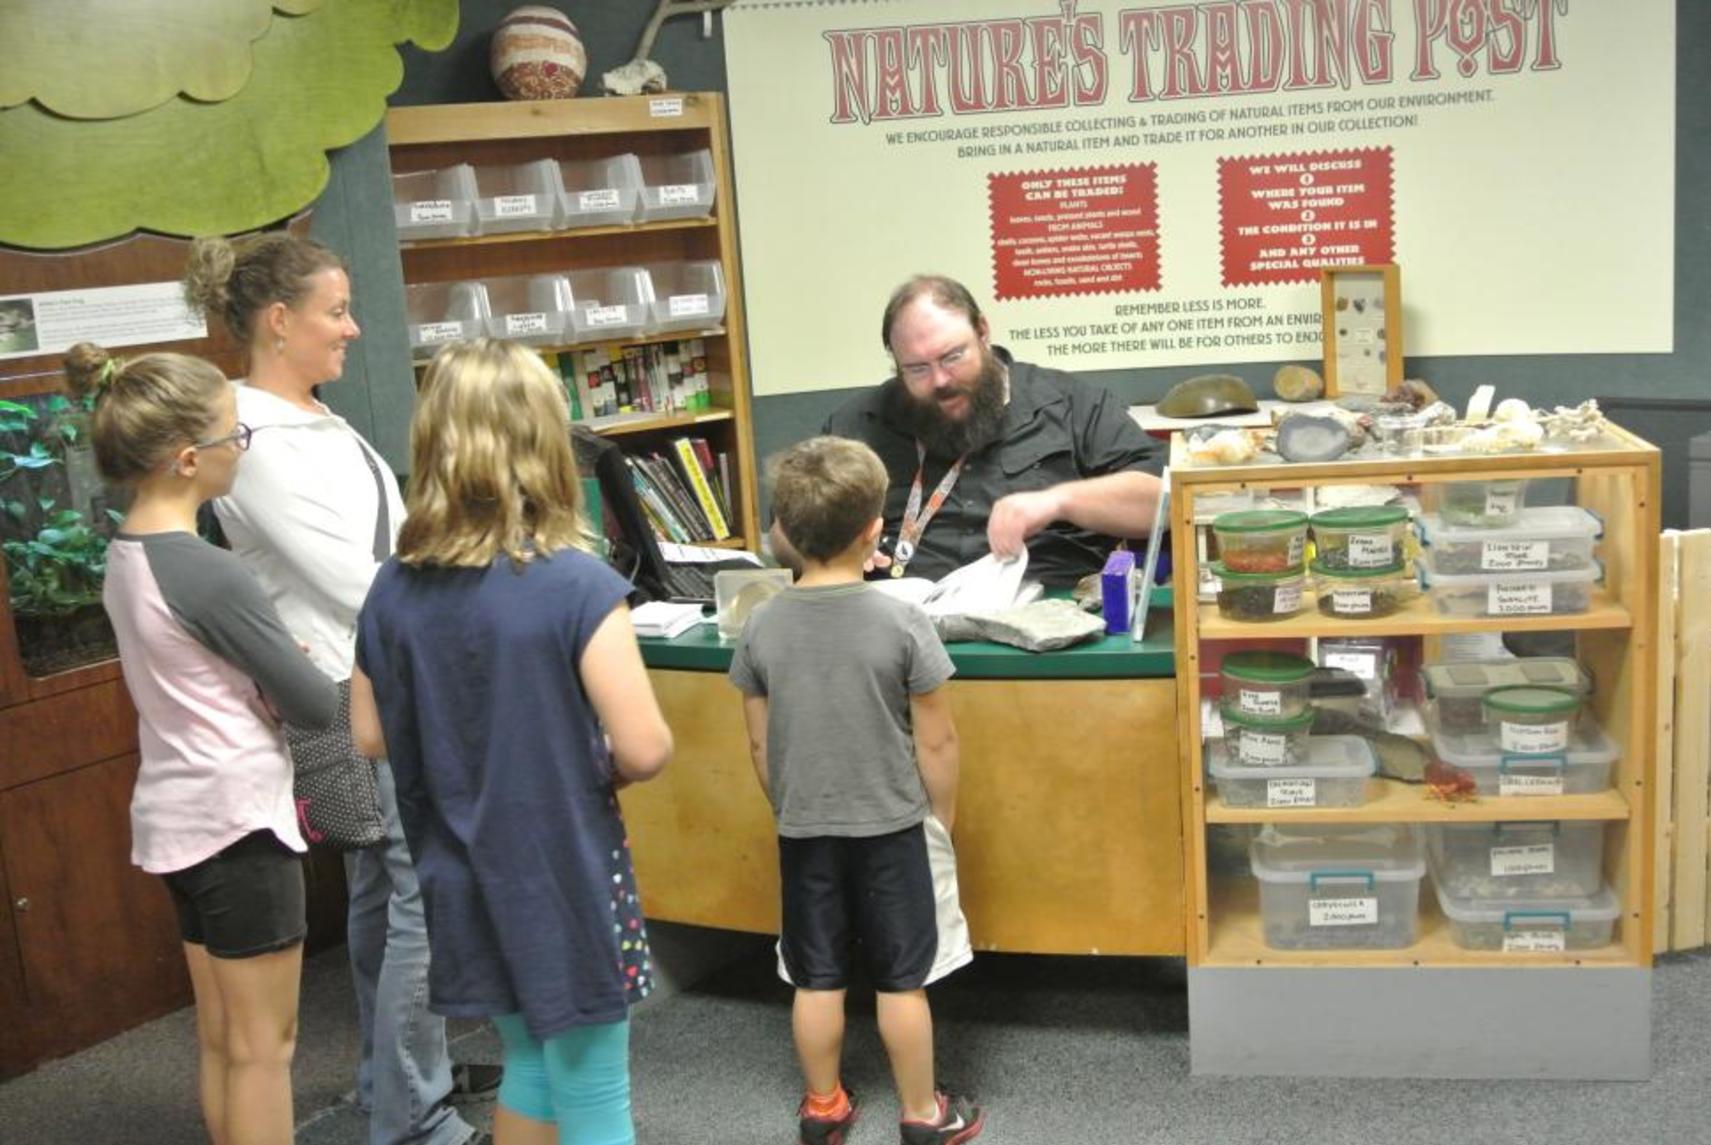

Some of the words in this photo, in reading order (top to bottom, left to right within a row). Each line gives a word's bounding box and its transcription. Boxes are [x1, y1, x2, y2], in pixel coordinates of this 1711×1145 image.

[823, 0, 1109, 125] NATURE'S
[1119, 0, 1394, 101] TRADING
[1410, 0, 1568, 77] POST
[885, 132, 905, 144] WE
[907, 126, 978, 143] ENCOURAGE
[981, 121, 1062, 138] RESPONSIBLE
[1065, 116, 1136, 132] COLLECTING
[1139, 118, 1147, 127] &
[1150, 110, 1206, 126] TRADING
[1209, 110, 1226, 122] OF
[1230, 106, 1285, 120] NATURAL
[1288, 102, 1324, 116] ITEMS
[1327, 99, 1364, 113] FROM
[1366, 97, 1396, 110] OUR
[957, 144, 996, 158] BRING
[999, 143, 1012, 155] IN
[1014, 143, 1023, 154] A
[1026, 139, 1078, 153] NATURAL
[1082, 137, 1110, 150] ITEM
[1113, 135, 1140, 147] AND
[1143, 132, 1182, 145] TRADE
[1186, 130, 1196, 142] IT
[1200, 129, 1225, 141] FOR
[1228, 124, 1288, 139] ANOTHER
[1291, 122, 1304, 134] IN
[1307, 120, 1335, 133] OUR
[1249, 165, 1271, 175] WE
[1274, 163, 1306, 174] WILL
[1309, 159, 1362, 171] DISCUSS
[1021, 180, 1053, 190] ONLY
[1056, 177, 1090, 188] THESE
[1093, 174, 1127, 185] ITEMS
[1025, 191, 1051, 201] CAN
[1053, 189, 1069, 199] BE
[1251, 188, 1295, 198] WHERE
[1299, 186, 1334, 196] YOUR
[1336, 184, 1365, 193] ITEM
[1268, 200, 1299, 210] WAS
[1302, 197, 1344, 208] FOUND
[1238, 226, 1260, 236] THE
[1262, 222, 1331, 234] CONDITION
[1334, 221, 1346, 230] IT
[1348, 220, 1361, 229] IS
[1364, 219, 1378, 229] IN
[1259, 248, 1286, 258] AND
[1290, 247, 1316, 257] ANY
[1320, 244, 1360, 255] OTHER
[1250, 260, 1299, 271] SPECIAL
[1115, 301, 1180, 316] REMEMBER
[1182, 300, 1210, 312] LESS
[1212, 299, 1223, 311] IS
[1010, 328, 1031, 340] THE
[1034, 326, 1060, 339] LESS
[1063, 325, 1087, 337] YOU
[1090, 323, 1118, 335] TAKE
[1121, 322, 1138, 333] OF
[1141, 321, 1164, 332] ANY
[1167, 319, 1193, 331] ONE
[1197, 317, 1224, 329] ITEM
[1227, 315, 1263, 328] FROM
[1266, 314, 1283, 326] AN
[1047, 344, 1069, 356] THE
[1072, 342, 1107, 354] MORE
[1111, 340, 1146, 352] THERE
[1150, 337, 1178, 350] WILL
[1179, 336, 1193, 348] BE
[1196, 335, 1221, 348] FOR
[1224, 333, 1272, 346] OTHERS
[1275, 332, 1293, 344] TO
